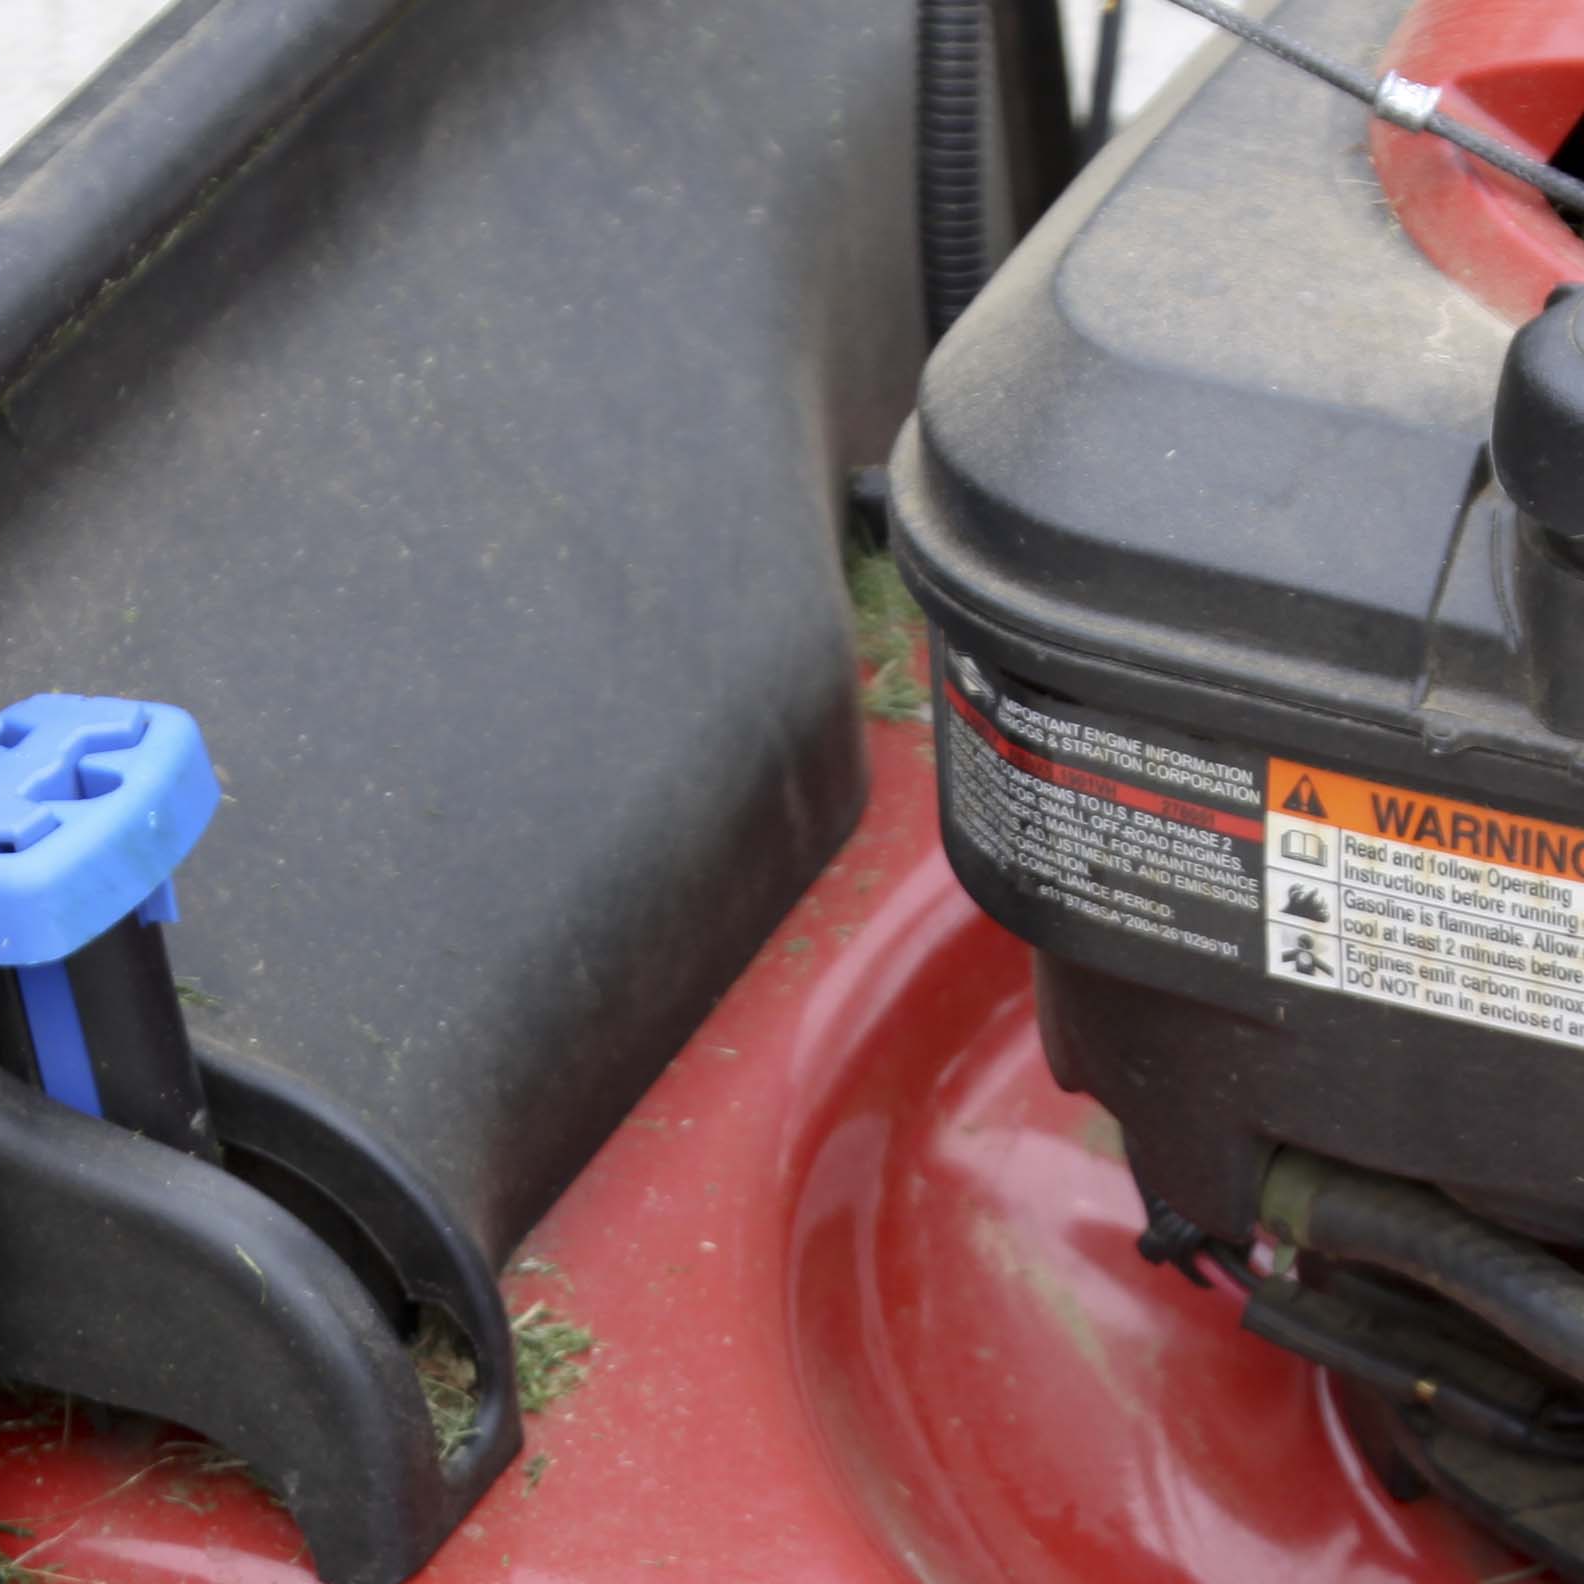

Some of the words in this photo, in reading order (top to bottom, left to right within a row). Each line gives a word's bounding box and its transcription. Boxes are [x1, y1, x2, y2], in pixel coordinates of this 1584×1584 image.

[1046, 733, 1059, 749] &
[1062, 737, 1143, 773] STRATTON
[1146, 762, 1261, 804] CORPORATION
[1084, 726, 1143, 756] ENGINE
[1145, 744, 1254, 786] INFORMATION
[999, 758, 1076, 804] CONFORMS
[1079, 793, 1100, 811] TO
[1134, 810, 1165, 832] EPA
[1167, 818, 1219, 847] PHASE
[1222, 837, 1232, 852] 2
[1008, 780, 1037, 804] FOR
[1039, 797, 1088, 827] SMALL
[1091, 814, 1170, 852] OFF-ROAD
[1172, 840, 1245, 873] ENGINES.
[1018, 852, 1111, 899] COMPLIANCE
[1045, 817, 1108, 849] MANUAL
[1112, 838, 1144, 864] FOR
[1146, 849, 1259, 891] MAINTENANCE
[1137, 863, 1172, 885] AND
[1174, 876, 1260, 911] EMISSIONS
[1344, 834, 1388, 863] Read
[1392, 851, 1425, 872] and
[1430, 854, 1483, 884] follow
[1487, 867, 1573, 908] Operating
[1343, 889, 1415, 923] Gasoline
[1419, 906, 1435, 927] is
[1438, 910, 1528, 949] flammable.
[1532, 931, 1579, 958] Allow
[1344, 859, 1446, 902] Instructions
[1451, 883, 1506, 913] before
[1511, 899, 1579, 934] running
[1344, 917, 1378, 939] cool
[1383, 927, 1399, 944] at
[1403, 927, 1443, 952] least
[1446, 937, 1457, 956] 2
[1460, 942, 1526, 972] minutes
[1531, 955, 1584, 985] before
[1345, 944, 1415, 976] Engines
[1419, 964, 1457, 986] emit
[1461, 975, 1521, 1001] carbon
[1345, 966, 1375, 989] DO
[1379, 974, 1419, 999] NOT
[1424, 988, 1455, 1007] run
[1459, 990, 1475, 1013] in
[1478, 1000, 1564, 1033] enclosed
